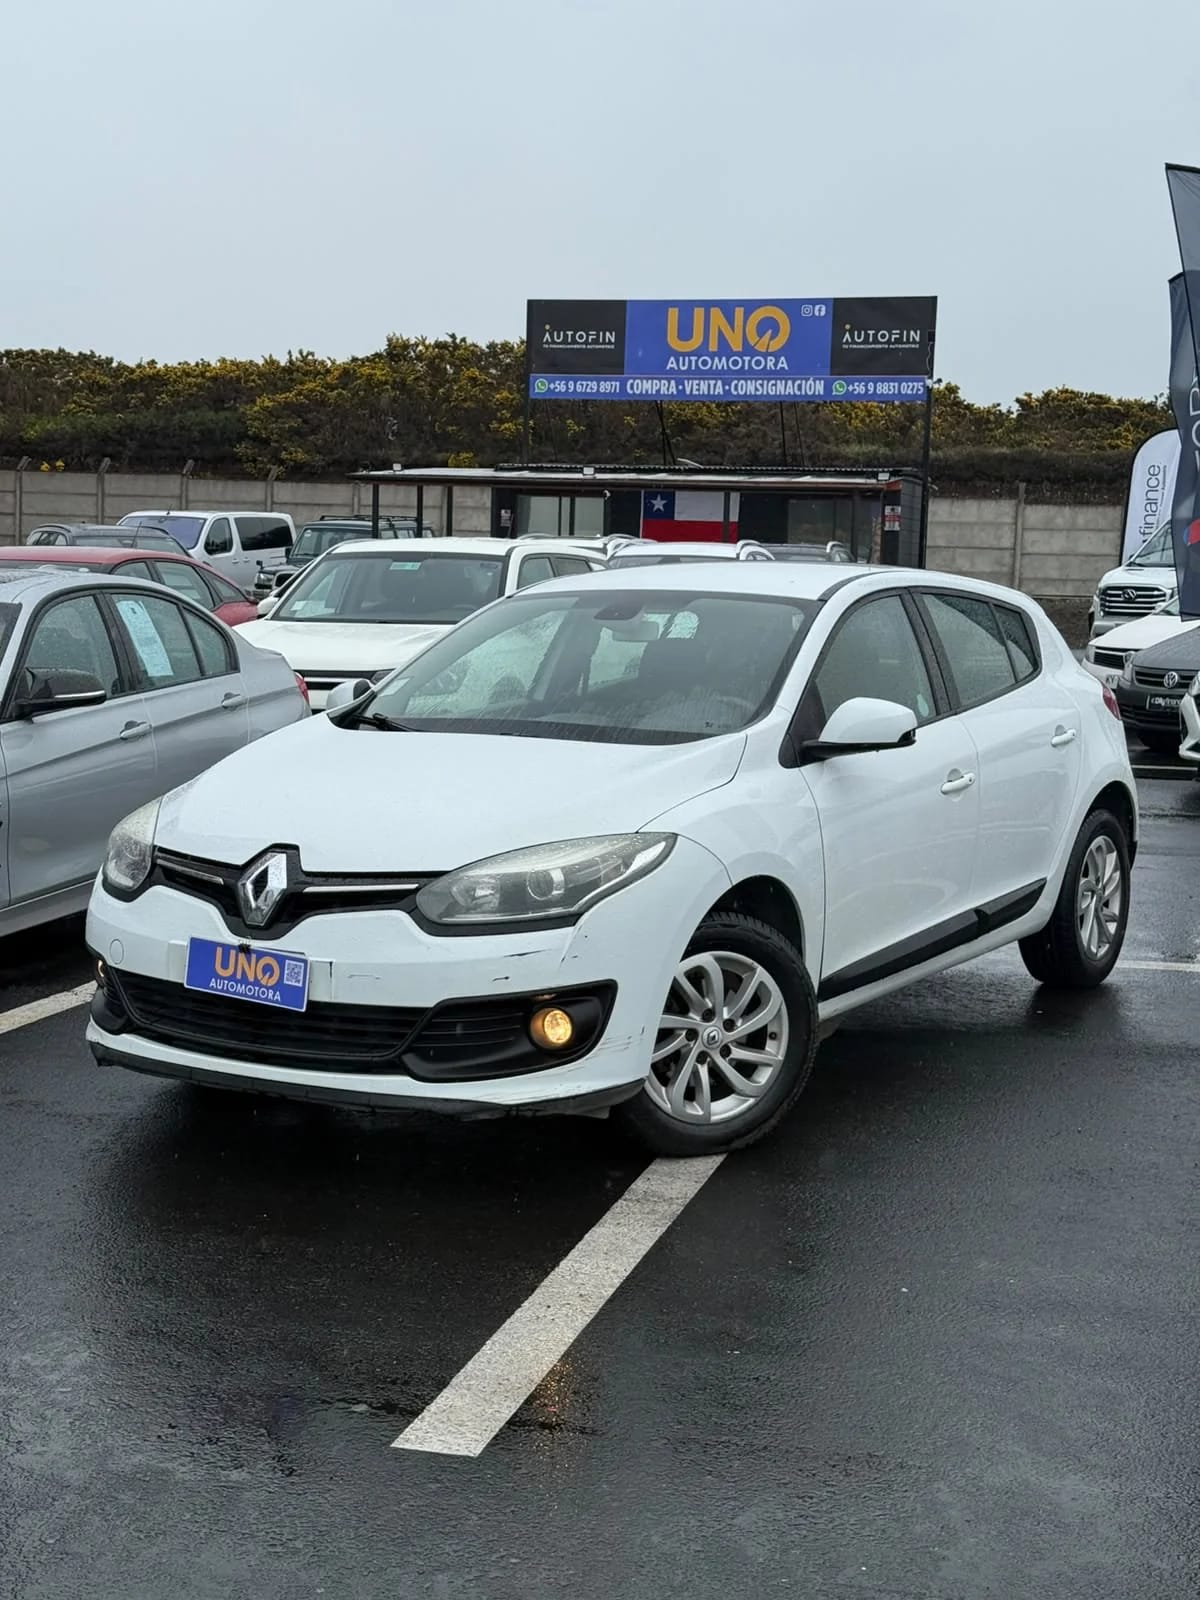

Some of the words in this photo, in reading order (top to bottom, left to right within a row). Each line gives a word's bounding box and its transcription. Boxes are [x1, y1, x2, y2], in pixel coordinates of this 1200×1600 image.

[543, 324, 615, 343] AUTOFIN
[667, 305, 791, 352] UNO
[842, 323, 920, 343] AUTOFIN
[666, 356, 789, 371] AUTOMOTORA
[549, 380, 566, 392] +56
[568, 380, 573, 392] 9
[576, 380, 598, 393] 6729
[599, 381, 620, 393] 8971
[626, 379, 677, 395] COMPRA
[684, 379, 724, 395] VENTA
[731, 377, 825, 396] CONSIGNACIÓN
[847, 382, 865, 394] +56
[868, 382, 873, 394] 9
[876, 382, 899, 394] 8831
[900, 382, 924, 395] 0275
[215, 946, 280, 987] UNO
[209, 978, 281, 1001] AUTOMOTORA
